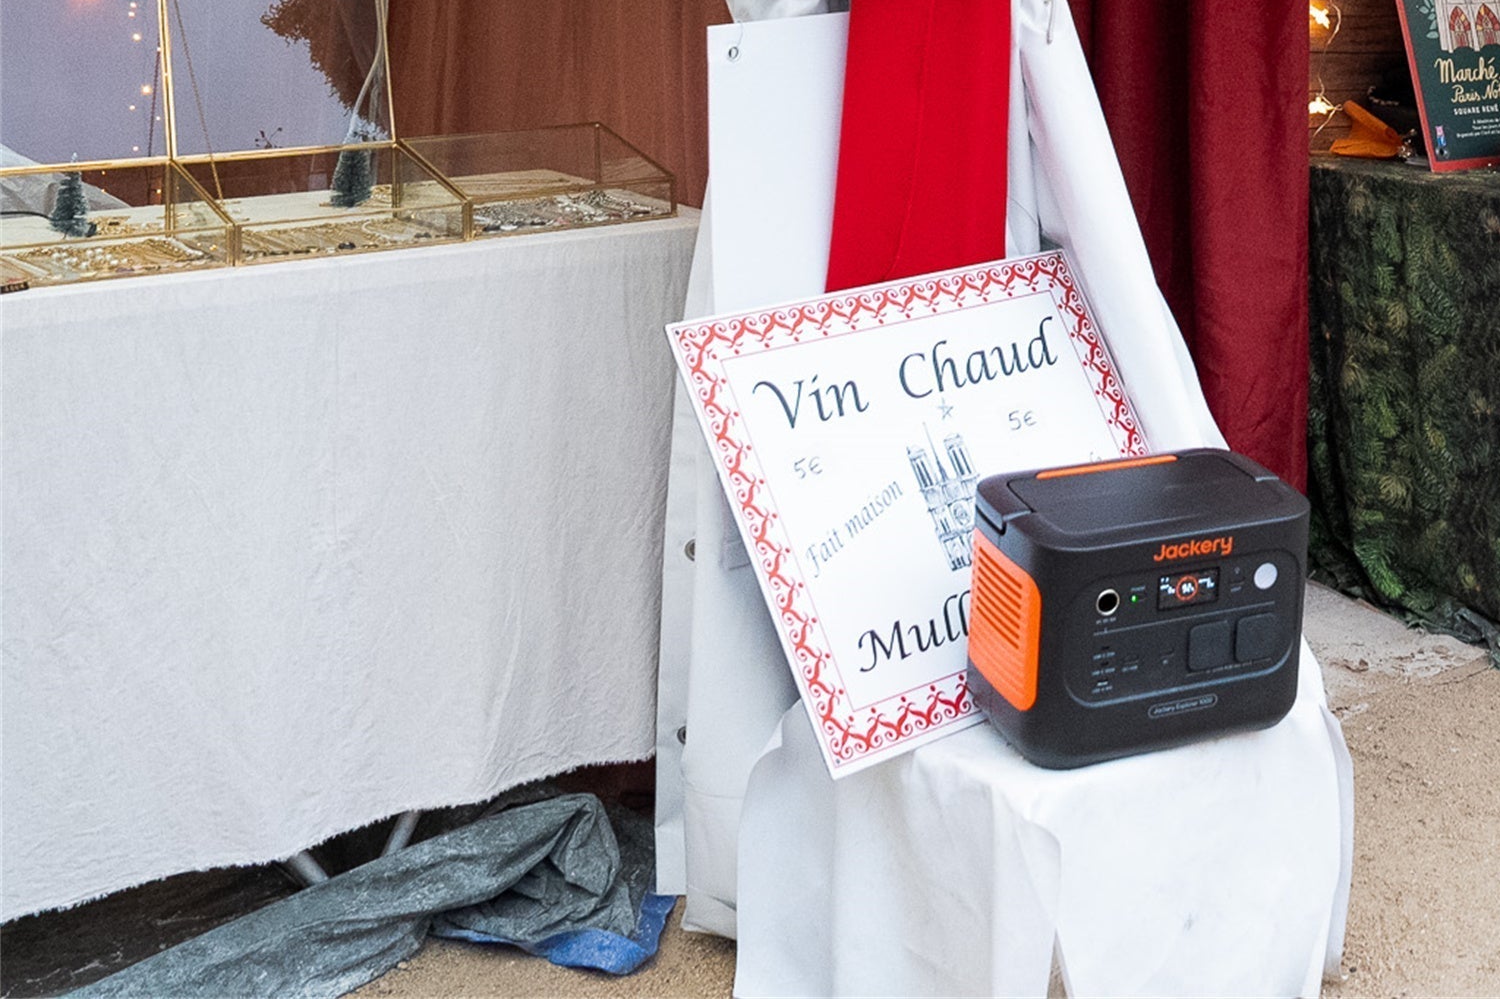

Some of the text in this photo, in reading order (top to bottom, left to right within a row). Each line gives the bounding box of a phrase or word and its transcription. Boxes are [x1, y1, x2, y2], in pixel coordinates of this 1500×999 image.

[1434, 56, 1498, 84] Marché
[1451, 84, 1481, 104] Paris
[1453, 106, 1480, 115] SQUARE
[1482, 103, 1499, 112] RENÉ
[752, 315, 1059, 429] Vin Chaud
[805, 480, 904, 579] Fait maison
[1153, 535, 1234, 562] Jackery
